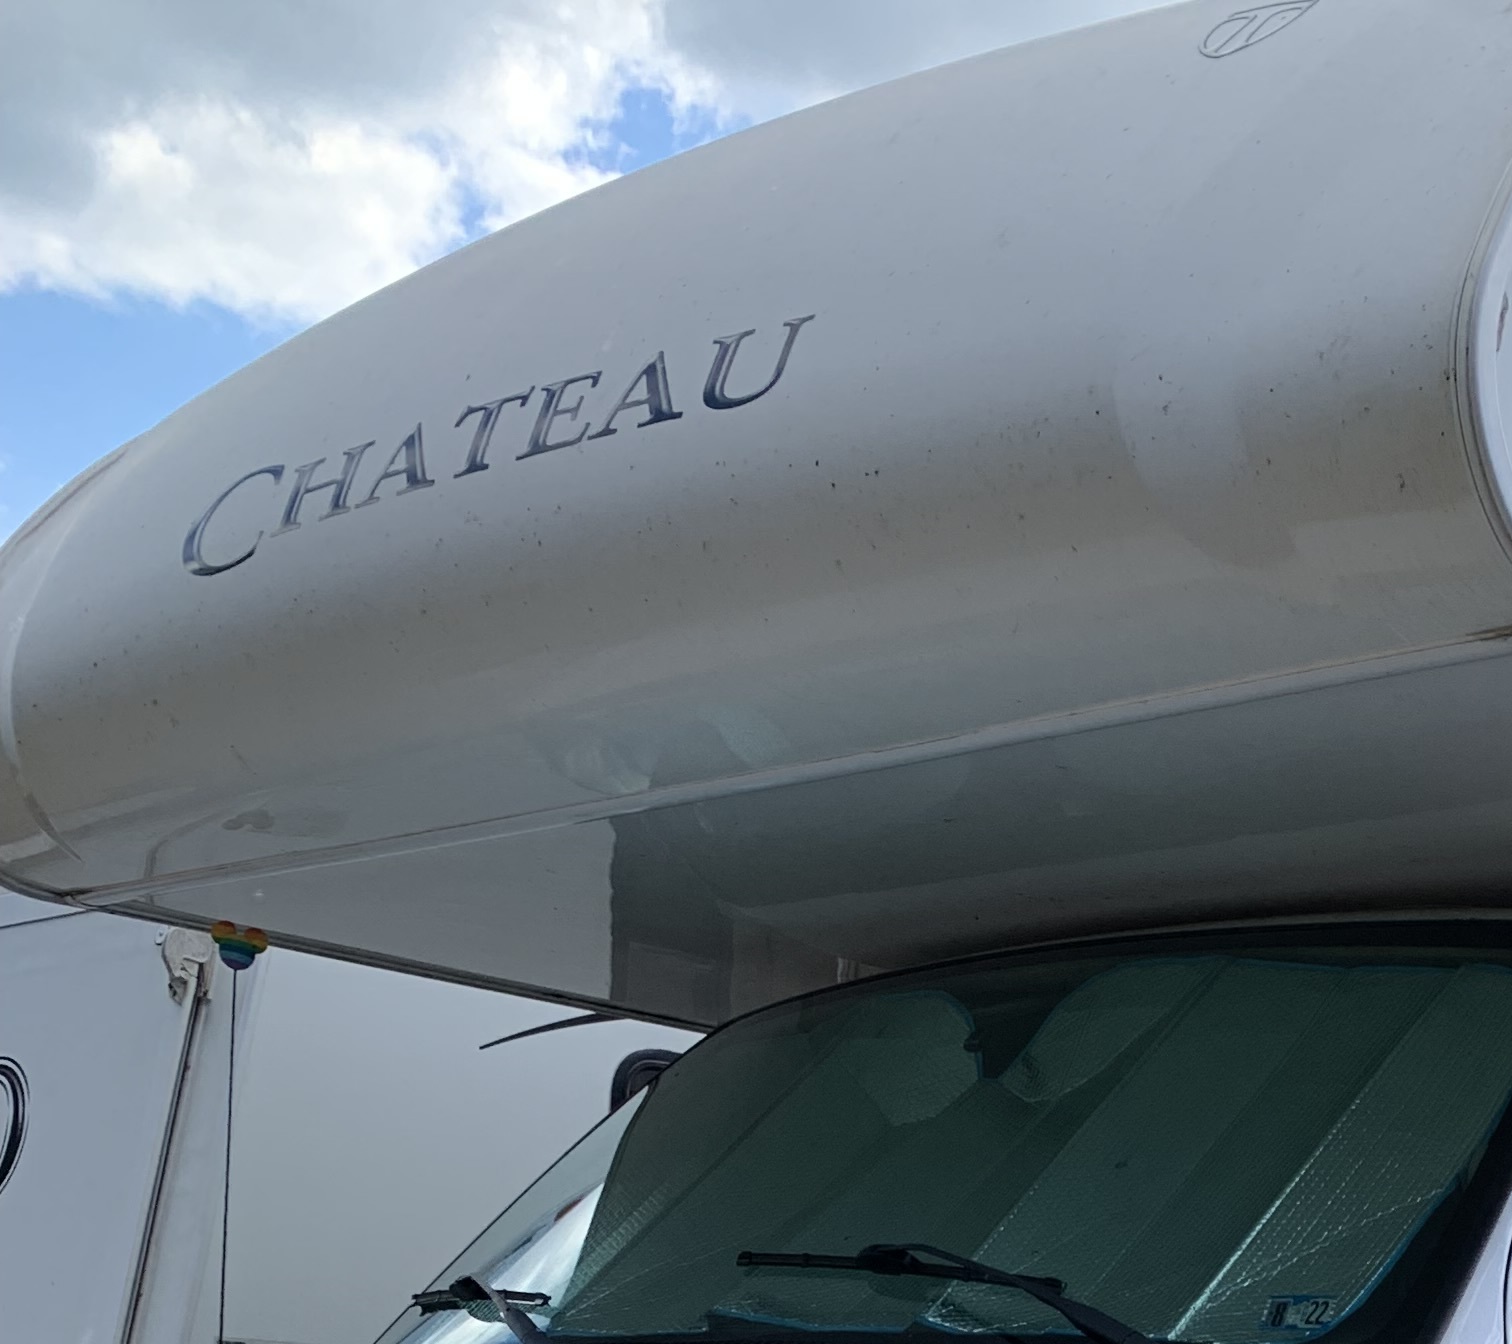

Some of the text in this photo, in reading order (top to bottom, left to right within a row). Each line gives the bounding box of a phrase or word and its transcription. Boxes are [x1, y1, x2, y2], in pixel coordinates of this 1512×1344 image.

[181, 313, 815, 577] CHATEAU
[1270, 1301, 1330, 1327] 8 22
